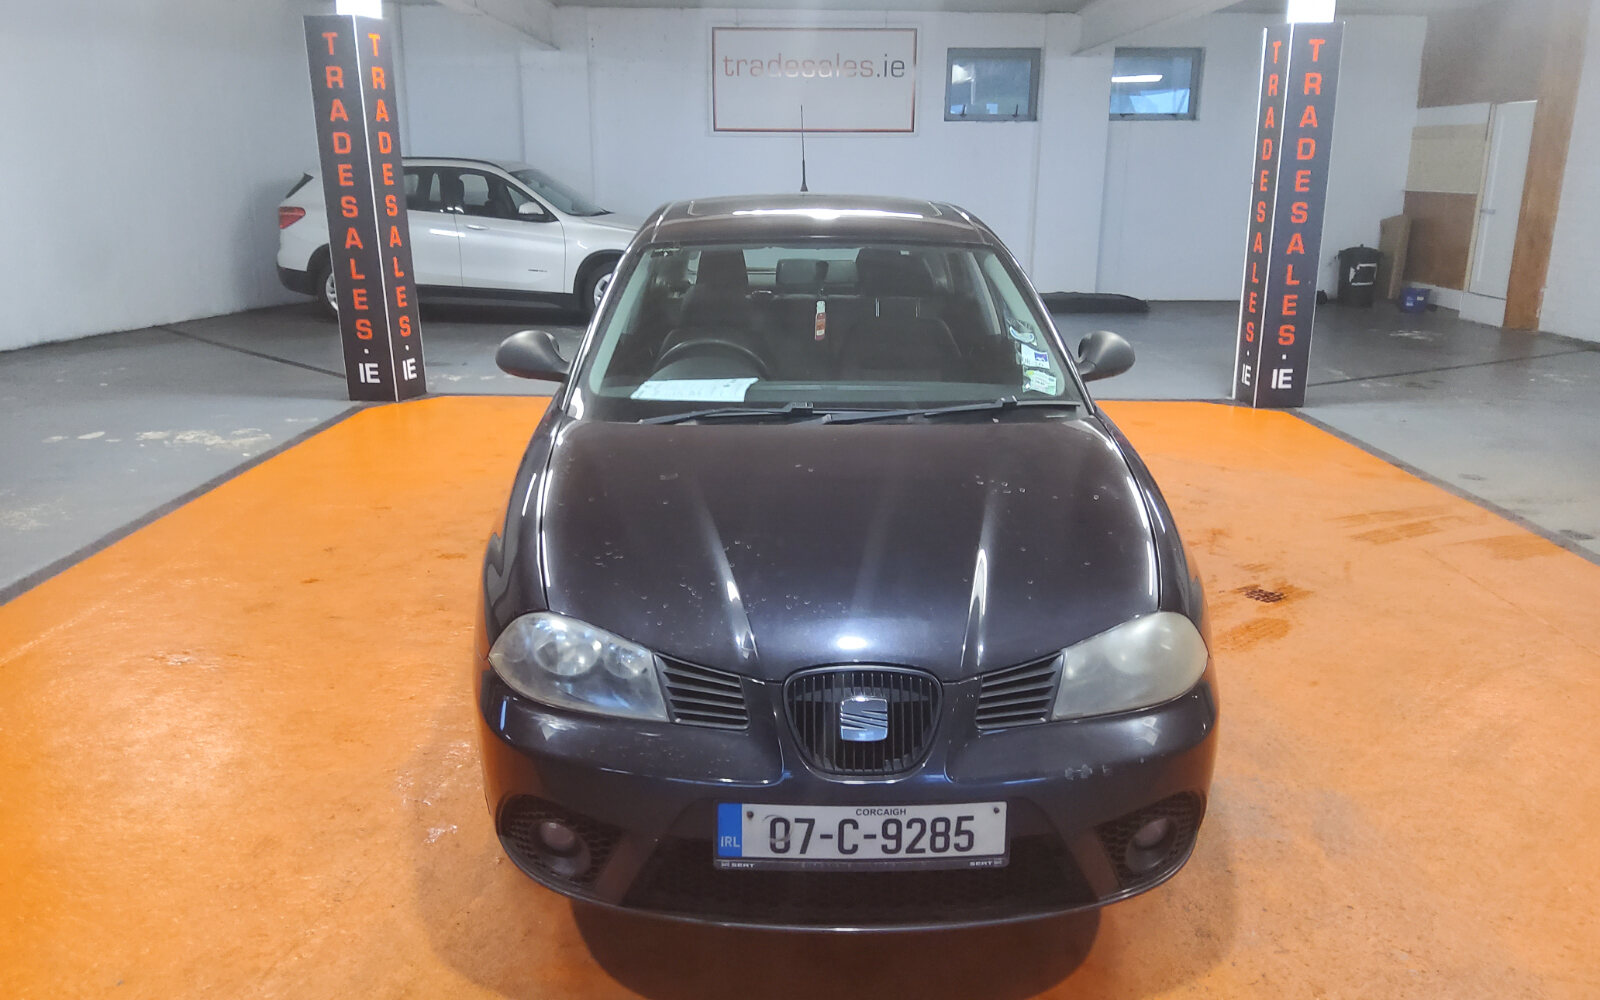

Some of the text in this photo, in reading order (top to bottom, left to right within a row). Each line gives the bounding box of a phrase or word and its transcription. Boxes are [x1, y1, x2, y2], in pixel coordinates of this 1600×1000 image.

[723, 53, 905, 78] tradesales.ie
[855, 808, 907, 816] CORCAIGH
[720, 836, 740, 848] IRL
[768, 815, 975, 855] 07-C-9285
